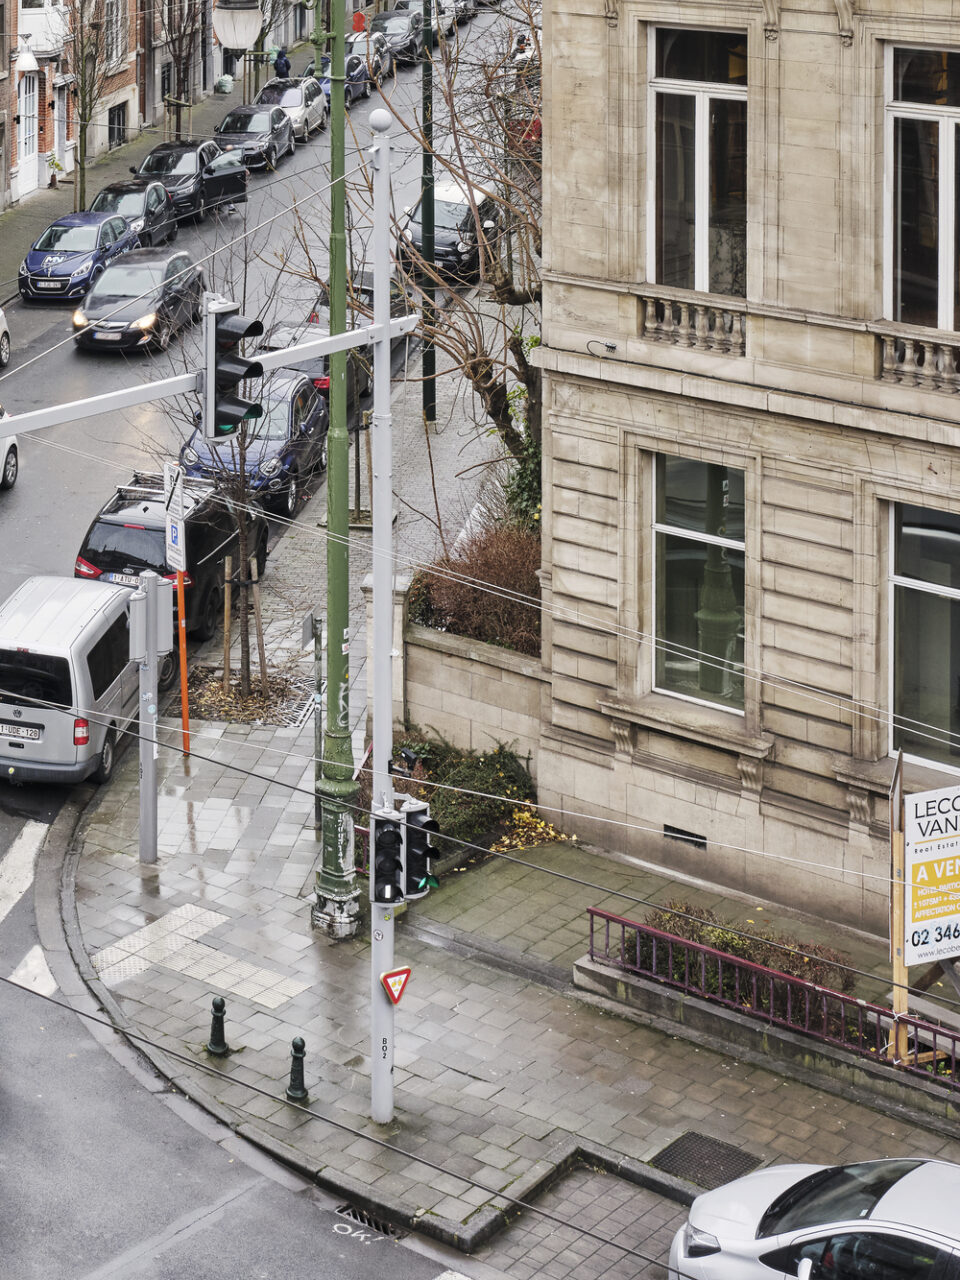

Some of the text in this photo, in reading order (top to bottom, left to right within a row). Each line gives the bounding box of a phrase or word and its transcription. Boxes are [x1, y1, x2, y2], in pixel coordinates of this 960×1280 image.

[917, 815, 960, 837] VAN
[915, 846, 933, 854] Real
[917, 865, 928, 882] A
[911, 929, 930, 947] 02
